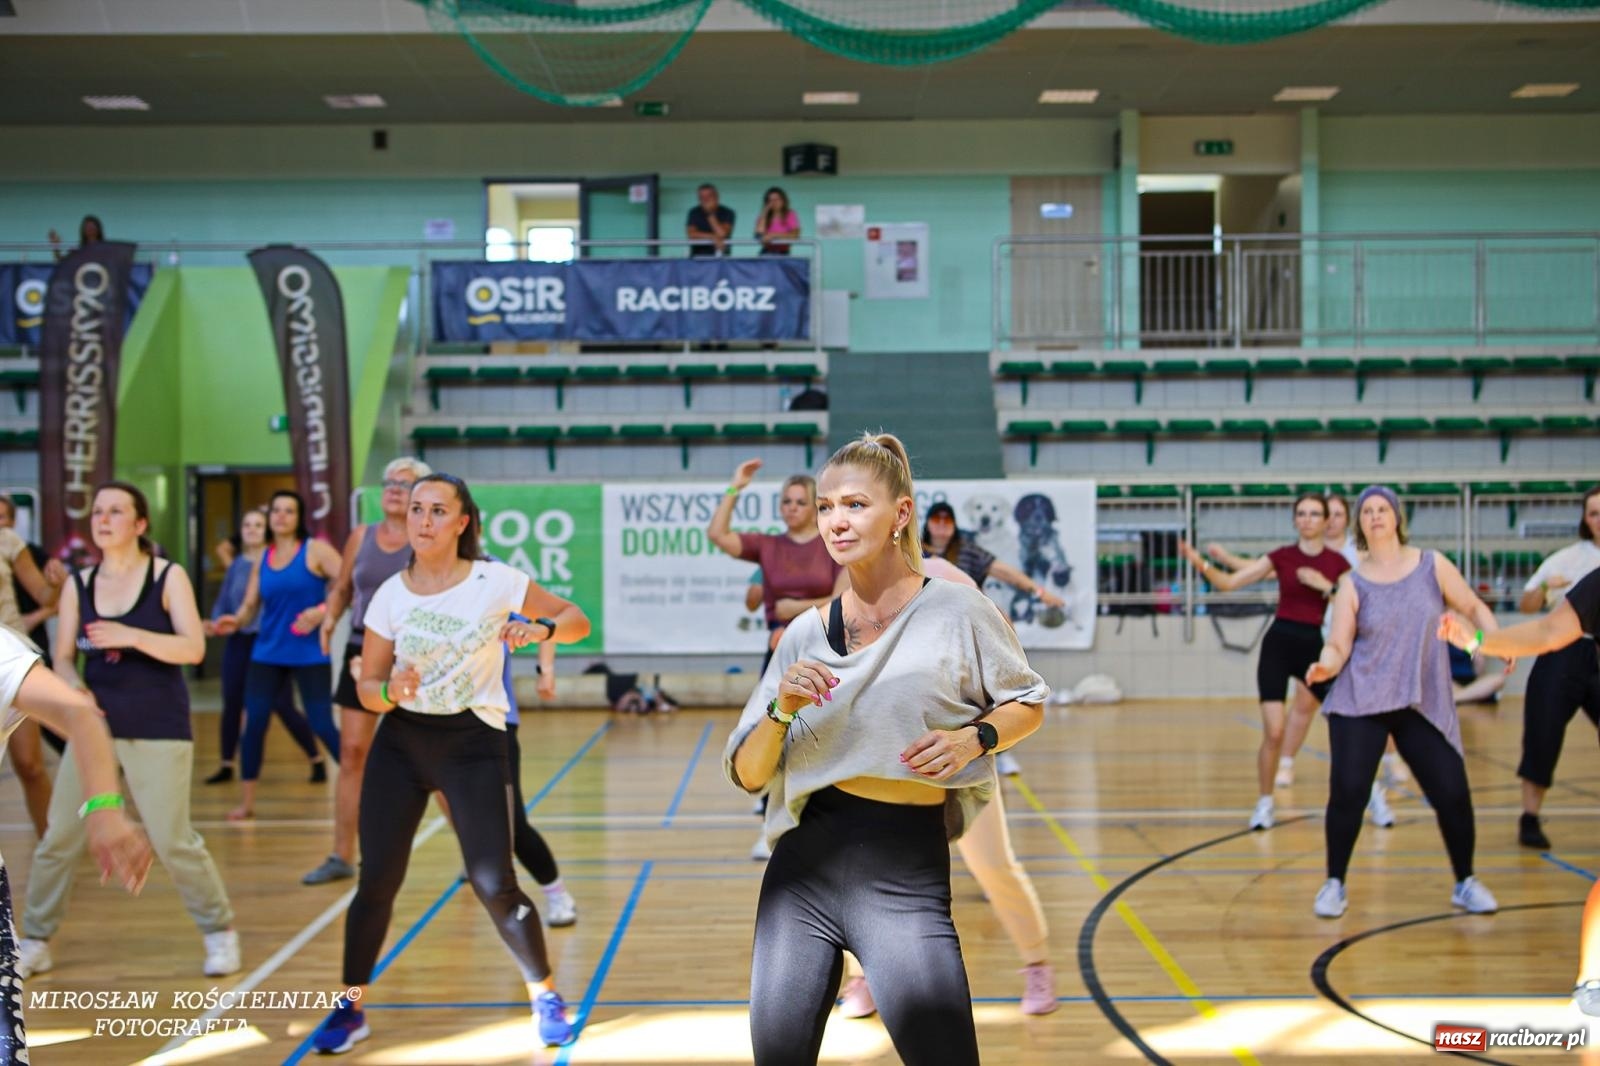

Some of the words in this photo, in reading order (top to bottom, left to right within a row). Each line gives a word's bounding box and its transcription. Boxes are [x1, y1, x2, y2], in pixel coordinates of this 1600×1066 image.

[817, 154, 831, 171] F
[465, 277, 566, 312] OSiR
[616, 280, 777, 312] RACIBÓRZ
[479, 508, 575, 548] OO
